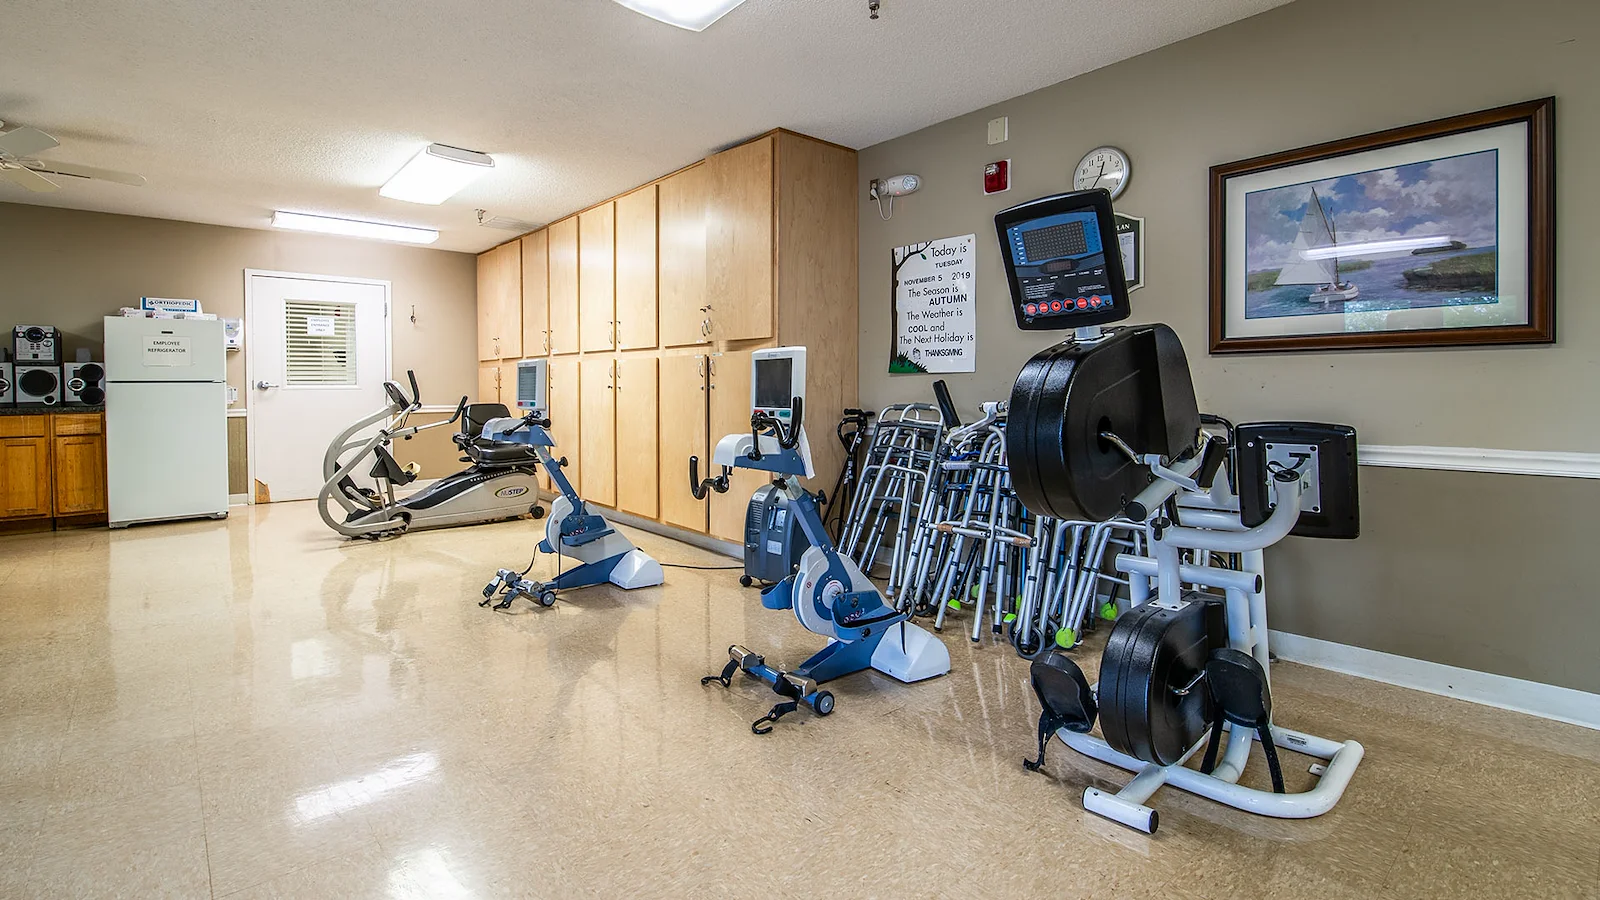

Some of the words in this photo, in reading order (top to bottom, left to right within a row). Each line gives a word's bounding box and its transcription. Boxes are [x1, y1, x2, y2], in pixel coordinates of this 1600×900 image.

[1097, 154, 1104, 162] 12
[1116, 223, 1130, 231] LAN
[931, 245, 957, 258] Today
[959, 243, 967, 254] is
[935, 259, 964, 269] TUESDAY
[904, 276, 936, 286] NOVEMBER
[938, 274, 943, 282] 5
[951, 271, 971, 281] 2019
[908, 288, 921, 298] The
[923, 287, 949, 296] Season
[952, 284, 959, 293] is
[929, 294, 967, 306] AUTUMN
[906, 311, 920, 321] The
[921, 308, 954, 319] Weather
[957, 308, 963, 316] is
[908, 325, 928, 333] COOL
[930, 321, 945, 332] and
[899, 336, 912, 345] The
[914, 334, 932, 344] Next
[933, 332, 965, 344] Holiday
[967, 332, 974, 341] is
[925, 348, 963, 357] THANKSGIVING
